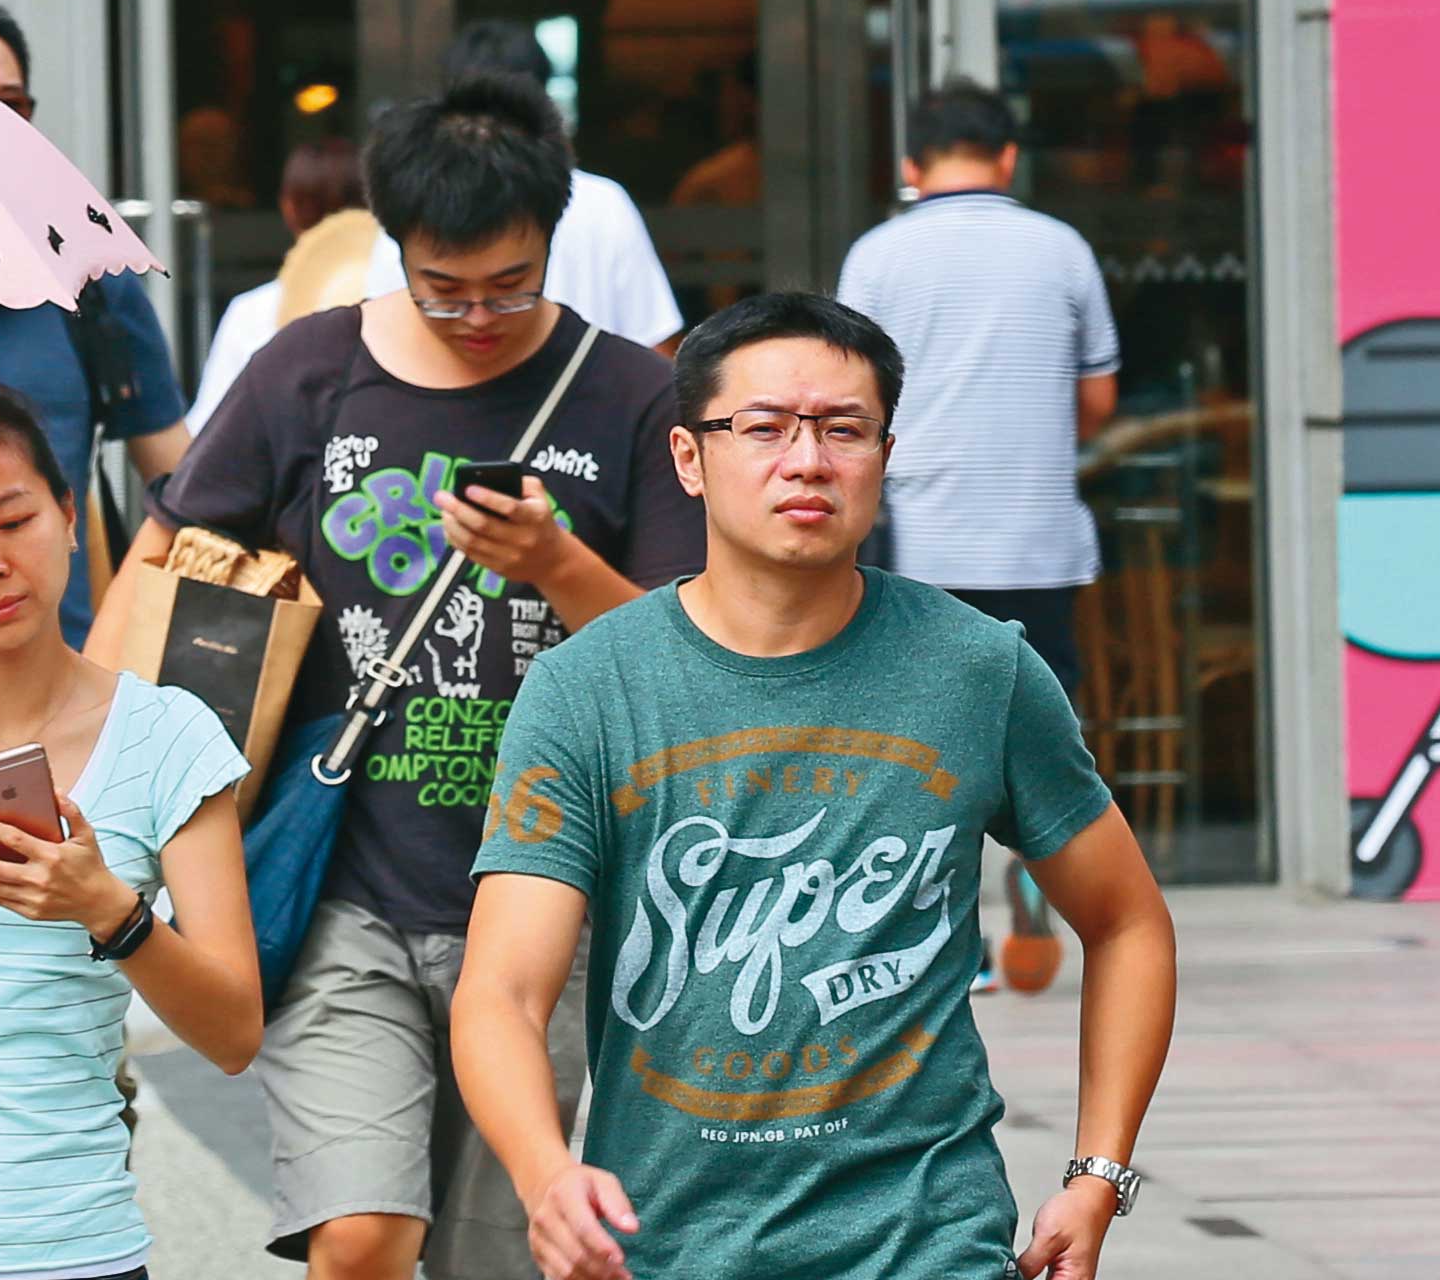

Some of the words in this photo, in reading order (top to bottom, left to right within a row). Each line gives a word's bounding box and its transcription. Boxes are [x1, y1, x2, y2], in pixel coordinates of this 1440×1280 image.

[417, 782, 491, 807] COO
[695, 765, 865, 807] FINERY
[692, 1035, 860, 1081] GOODS
[701, 1127, 729, 1143] REG
[732, 1129, 785, 1144] JPN.GB
[794, 1124, 821, 1140] PAT
[824, 1117, 849, 1134] OFF
